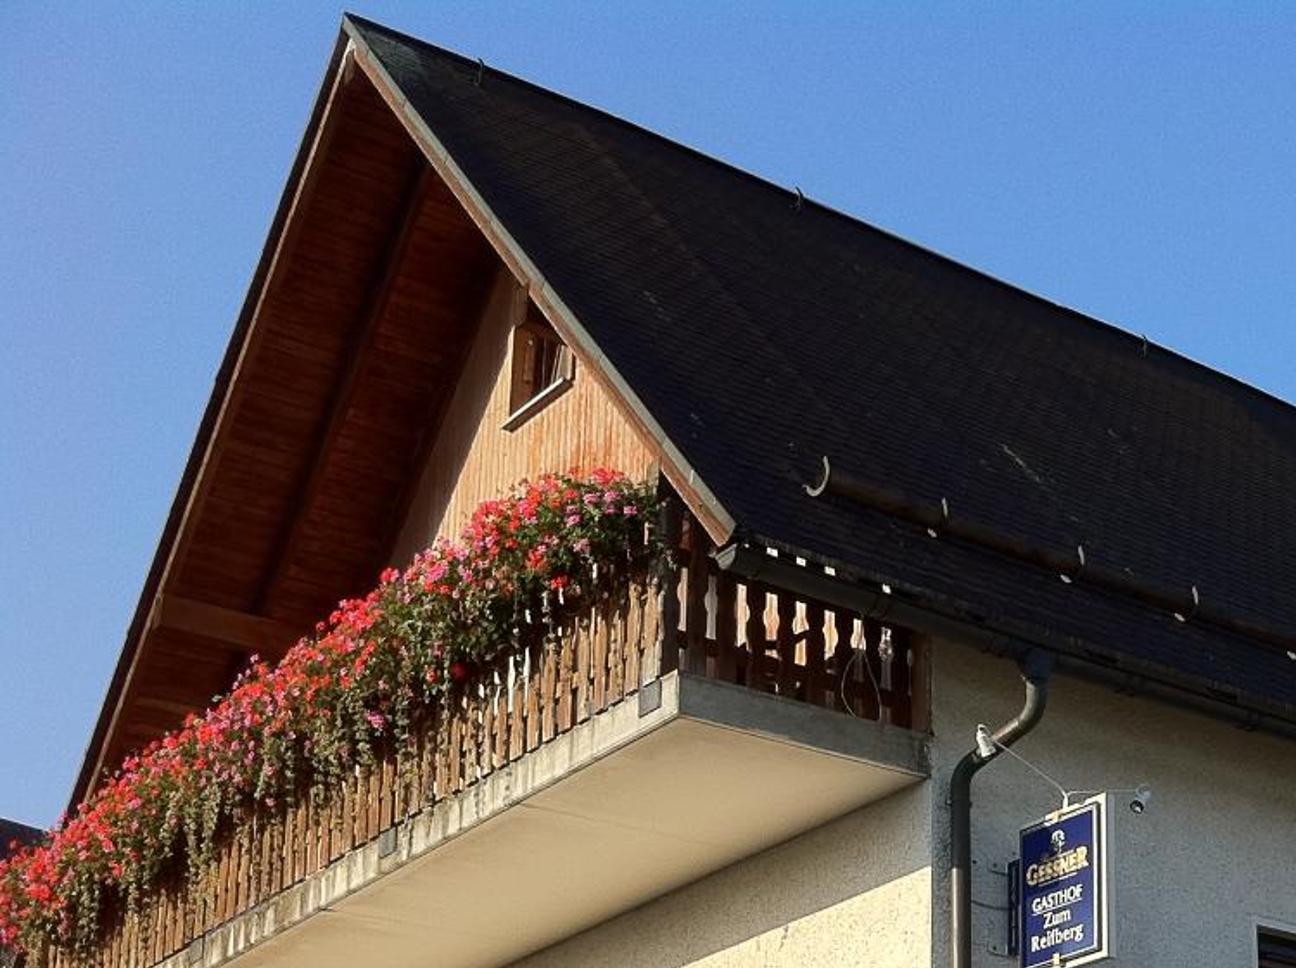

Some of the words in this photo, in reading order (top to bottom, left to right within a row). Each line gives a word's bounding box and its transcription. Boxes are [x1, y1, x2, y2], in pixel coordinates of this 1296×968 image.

[1026, 846, 1089, 886] GESSNER
[1031, 884, 1083, 914] GASTHOF
[1043, 909, 1071, 929] Zum
[1031, 924, 1084, 952] Reifberg
